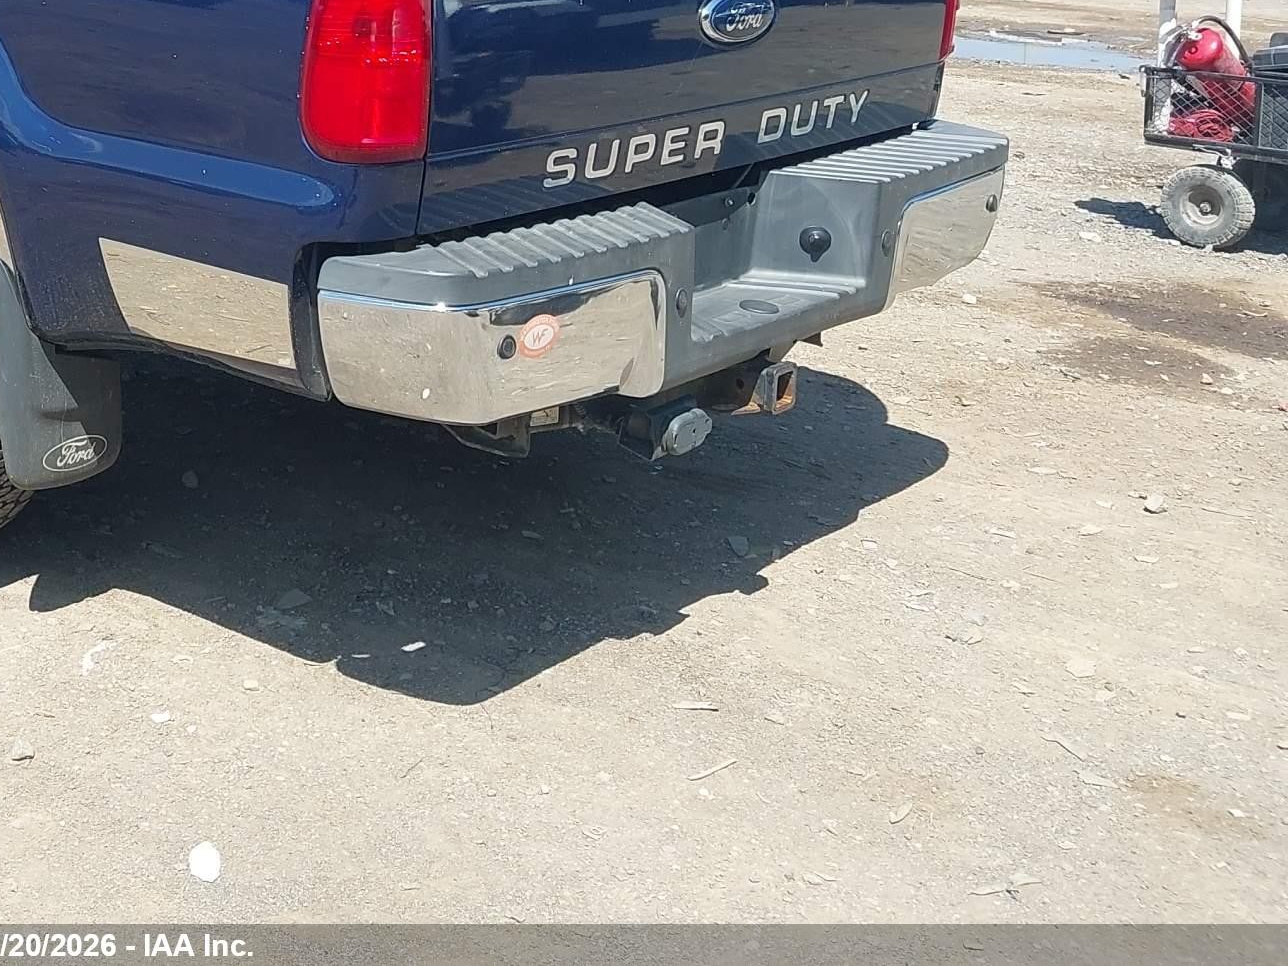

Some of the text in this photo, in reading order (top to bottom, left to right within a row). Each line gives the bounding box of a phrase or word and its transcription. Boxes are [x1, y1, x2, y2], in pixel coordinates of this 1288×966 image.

[542, 89, 871, 189] SUPER DUTY
[57, 440, 96, 466] Ford
